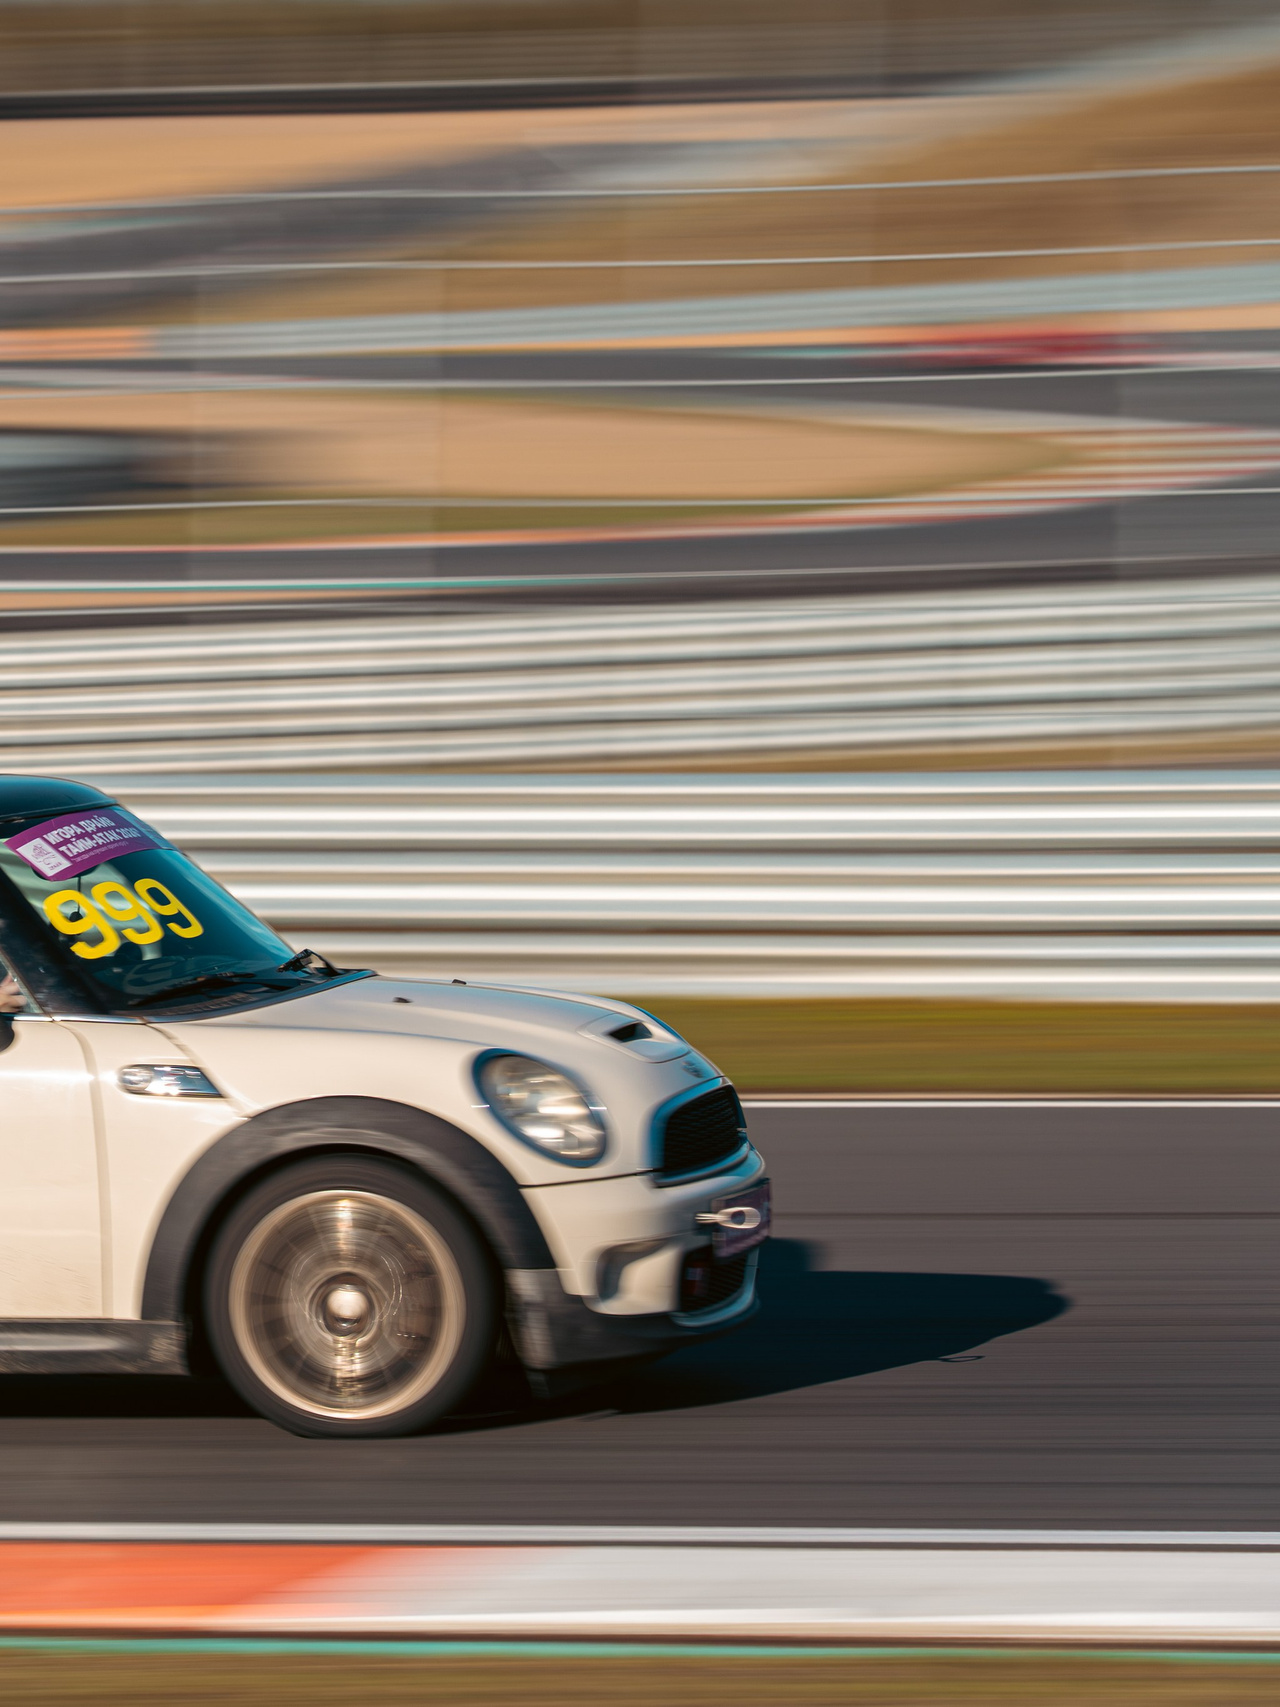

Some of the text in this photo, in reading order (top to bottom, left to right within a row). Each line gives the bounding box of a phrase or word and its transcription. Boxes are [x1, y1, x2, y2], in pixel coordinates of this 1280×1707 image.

[43, 815, 115, 844] ИГОРА ДРАЙВ
[58, 830, 119, 857] ТАЙМ-АТАК
[43, 878, 203, 959] 999
